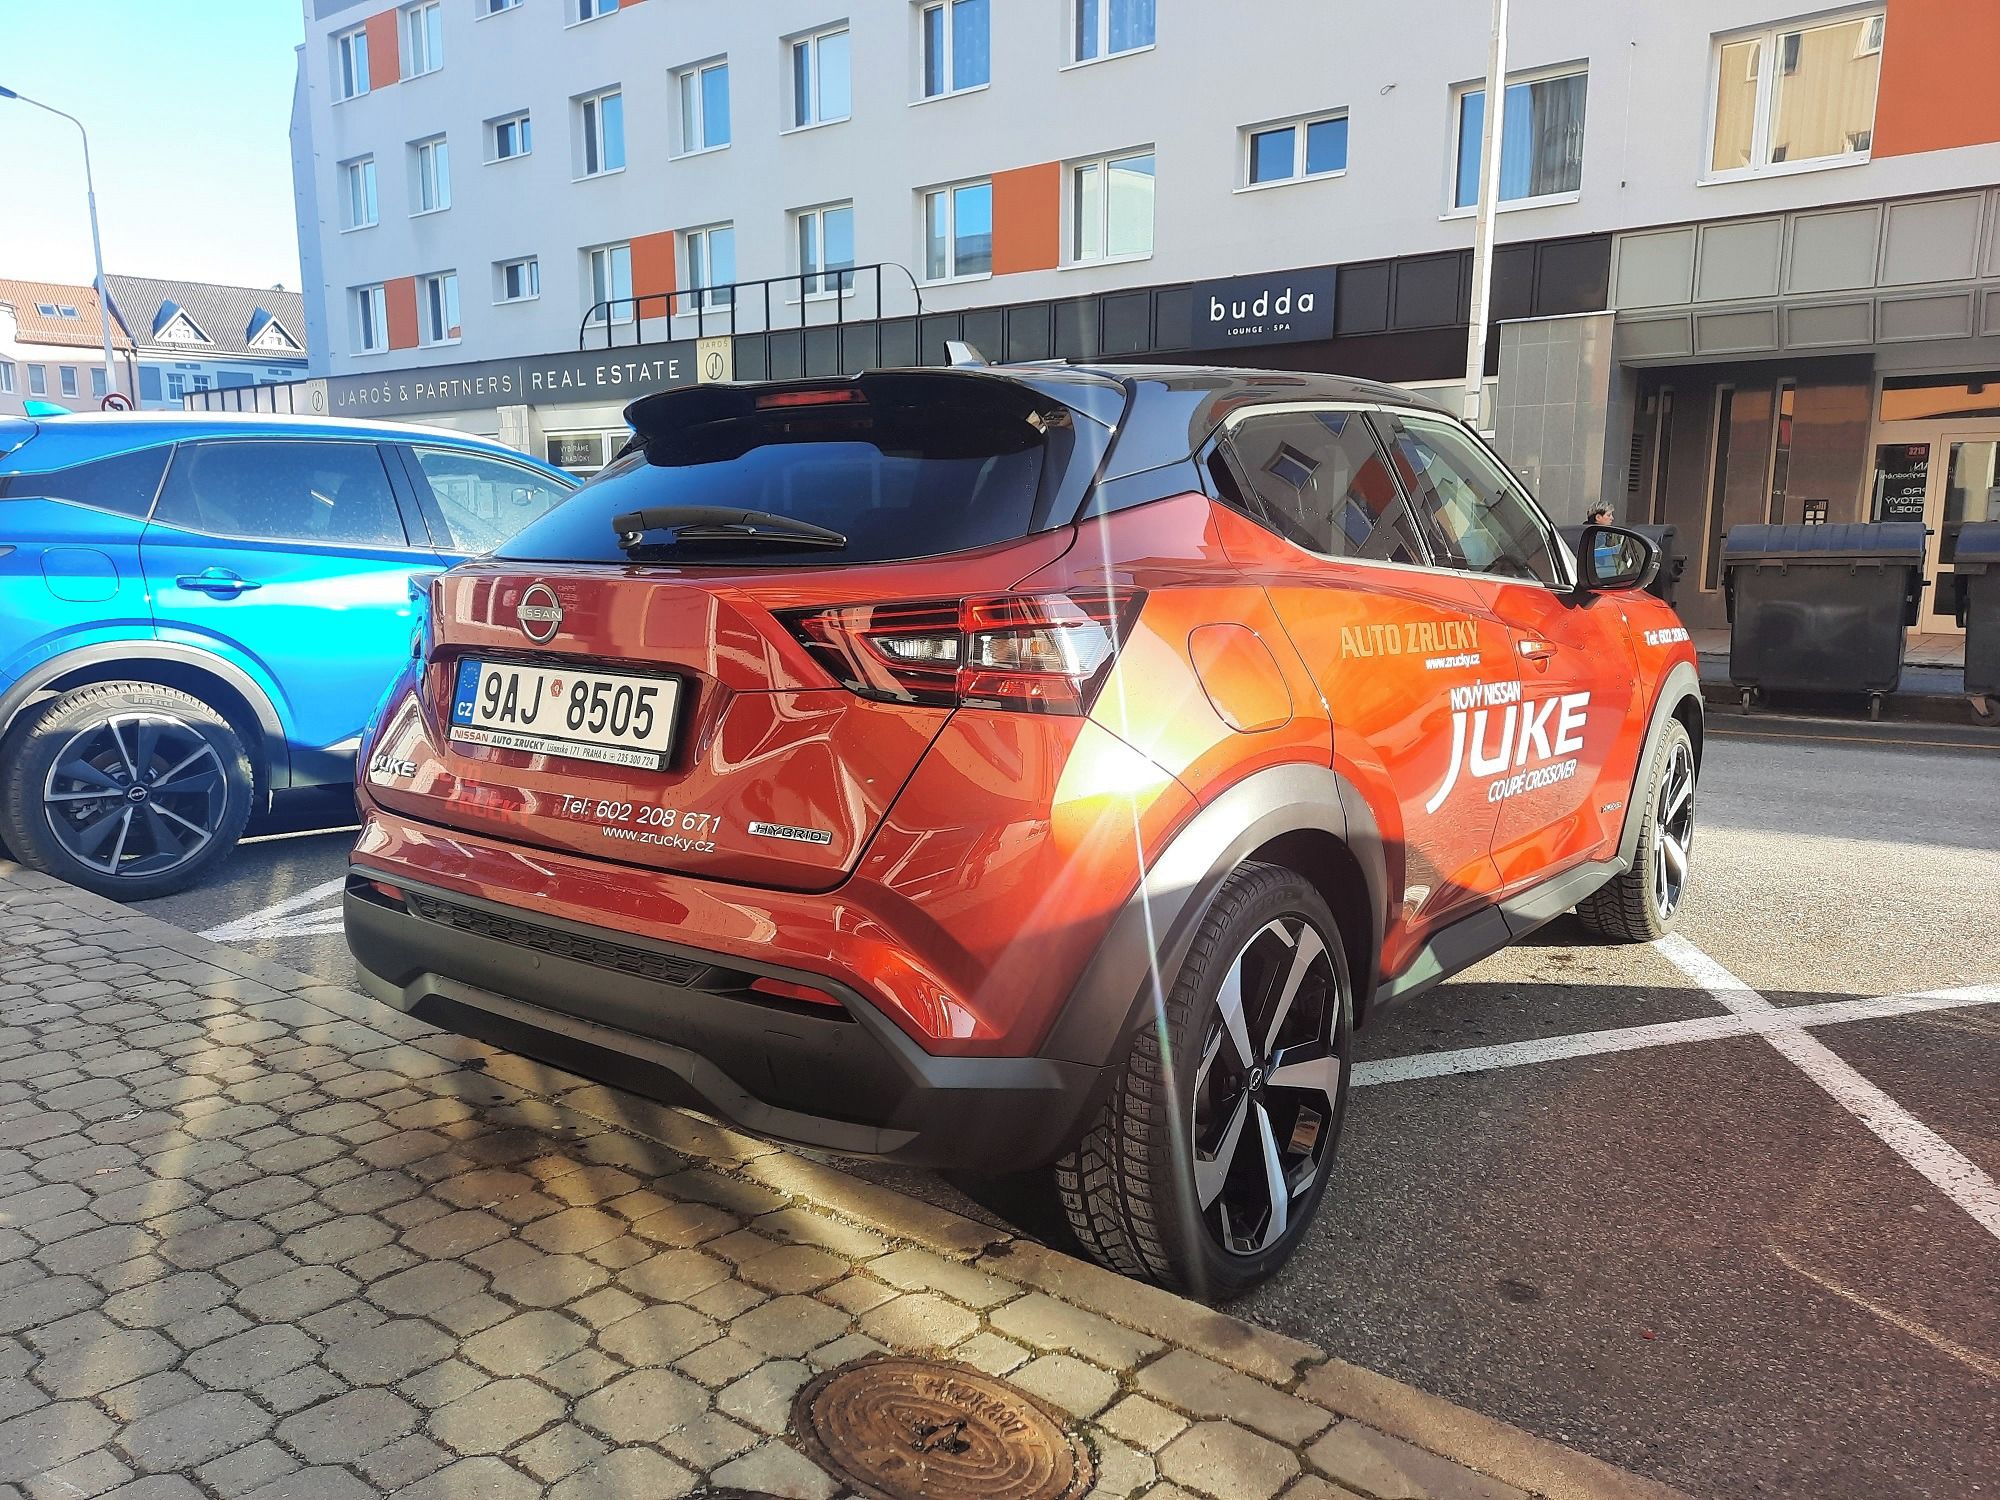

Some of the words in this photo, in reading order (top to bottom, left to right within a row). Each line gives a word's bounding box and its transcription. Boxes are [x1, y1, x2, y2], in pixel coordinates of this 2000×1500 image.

[1210, 288, 1314, 322] budda
[1228, 326, 1263, 336] LOUNGE
[1274, 323, 1291, 331] SPA
[338, 380, 392, 406] JAROŠ
[400, 385, 409, 401] &
[415, 375, 512, 400] PARTNERS
[532, 369, 587, 390] REAL
[596, 359, 680, 385] ESTATE
[518, 607, 561, 619] NISSAN
[1340, 623, 1402, 659] AUTO
[1404, 613, 1479, 654] ZRUCKÝ
[1425, 653, 1480, 670] www.zrucky.cz
[457, 702, 472, 717] CZ
[481, 671, 544, 725] 9AJ
[566, 680, 659, 740] 8505
[1451, 679, 1483, 711] NOVÝ
[1485, 680, 1521, 706] NISSAN
[454, 729, 489, 742] NISSAN
[491, 734, 512, 746] AUTO
[514, 737, 546, 751] ZRUCKÝ
[582, 747, 602, 759] PRAHA
[642, 757, 654, 767] 724
[1425, 691, 1591, 815] JUKE
[371, 753, 417, 778] JUKE
[1488, 769, 1527, 803] COUPÉ
[1525, 758, 1577, 792] CROSSOVER
[562, 794, 592, 815] Tel:
[596, 800, 632, 821] 602
[636, 806, 676, 828] 208
[681, 812, 721, 834] 671
[602, 826, 715, 853] www.zrucky.cz
[756, 824, 822, 841] HYBRID
